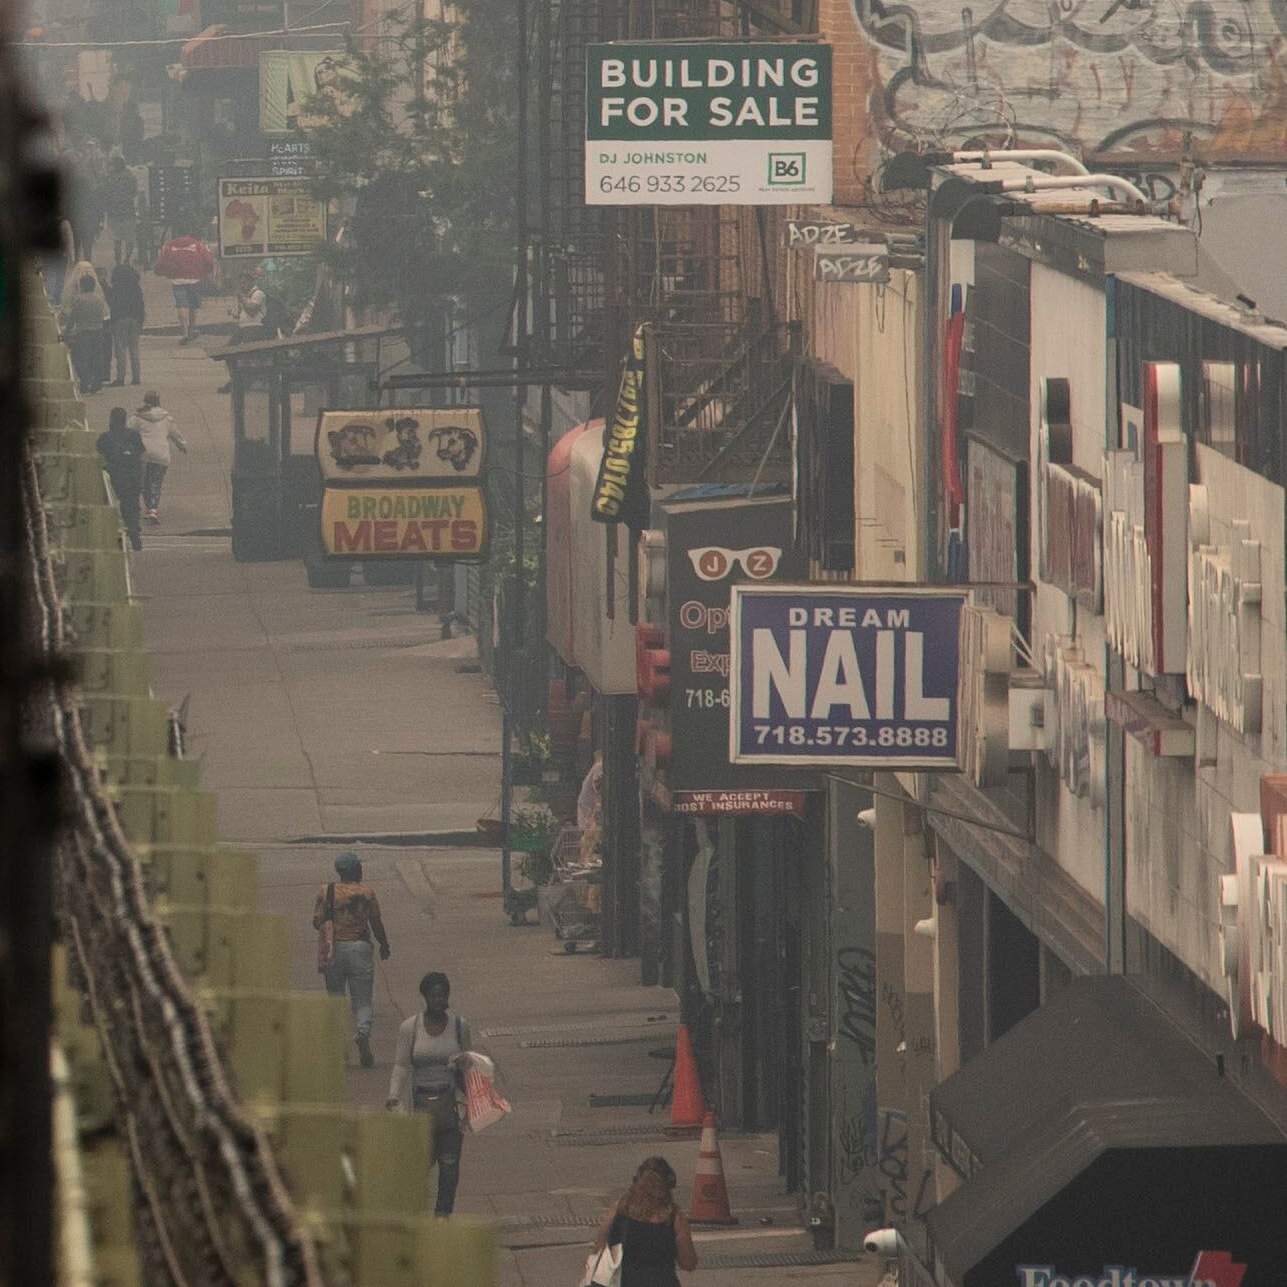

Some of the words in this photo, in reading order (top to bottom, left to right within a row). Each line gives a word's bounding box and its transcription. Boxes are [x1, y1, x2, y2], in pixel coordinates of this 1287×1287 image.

[601, 58, 819, 88] BUILDING
[601, 97, 689, 126] FOR
[709, 97, 819, 126] SALE
[599, 152, 617, 164] DJ
[623, 152, 708, 164] JOHNSTON
[775, 160, 799, 177] B6
[599, 175, 641, 193] 646
[647, 175, 686, 193] 933
[691, 175, 741, 193] 2625
[347, 495, 465, 520] BROADWAY
[334, 520, 477, 552] MEATS
[709, 556, 719, 571] J
[753, 557, 767, 571] Z
[789, 607, 911, 628] DREAM
[752, 628, 950, 721] NAIL
[753, 725, 948, 747] 718.573.8888
[692, 793, 713, 802] WE
[719, 792, 770, 802] ACCEPT
[711, 801, 794, 811] INSURANCES
